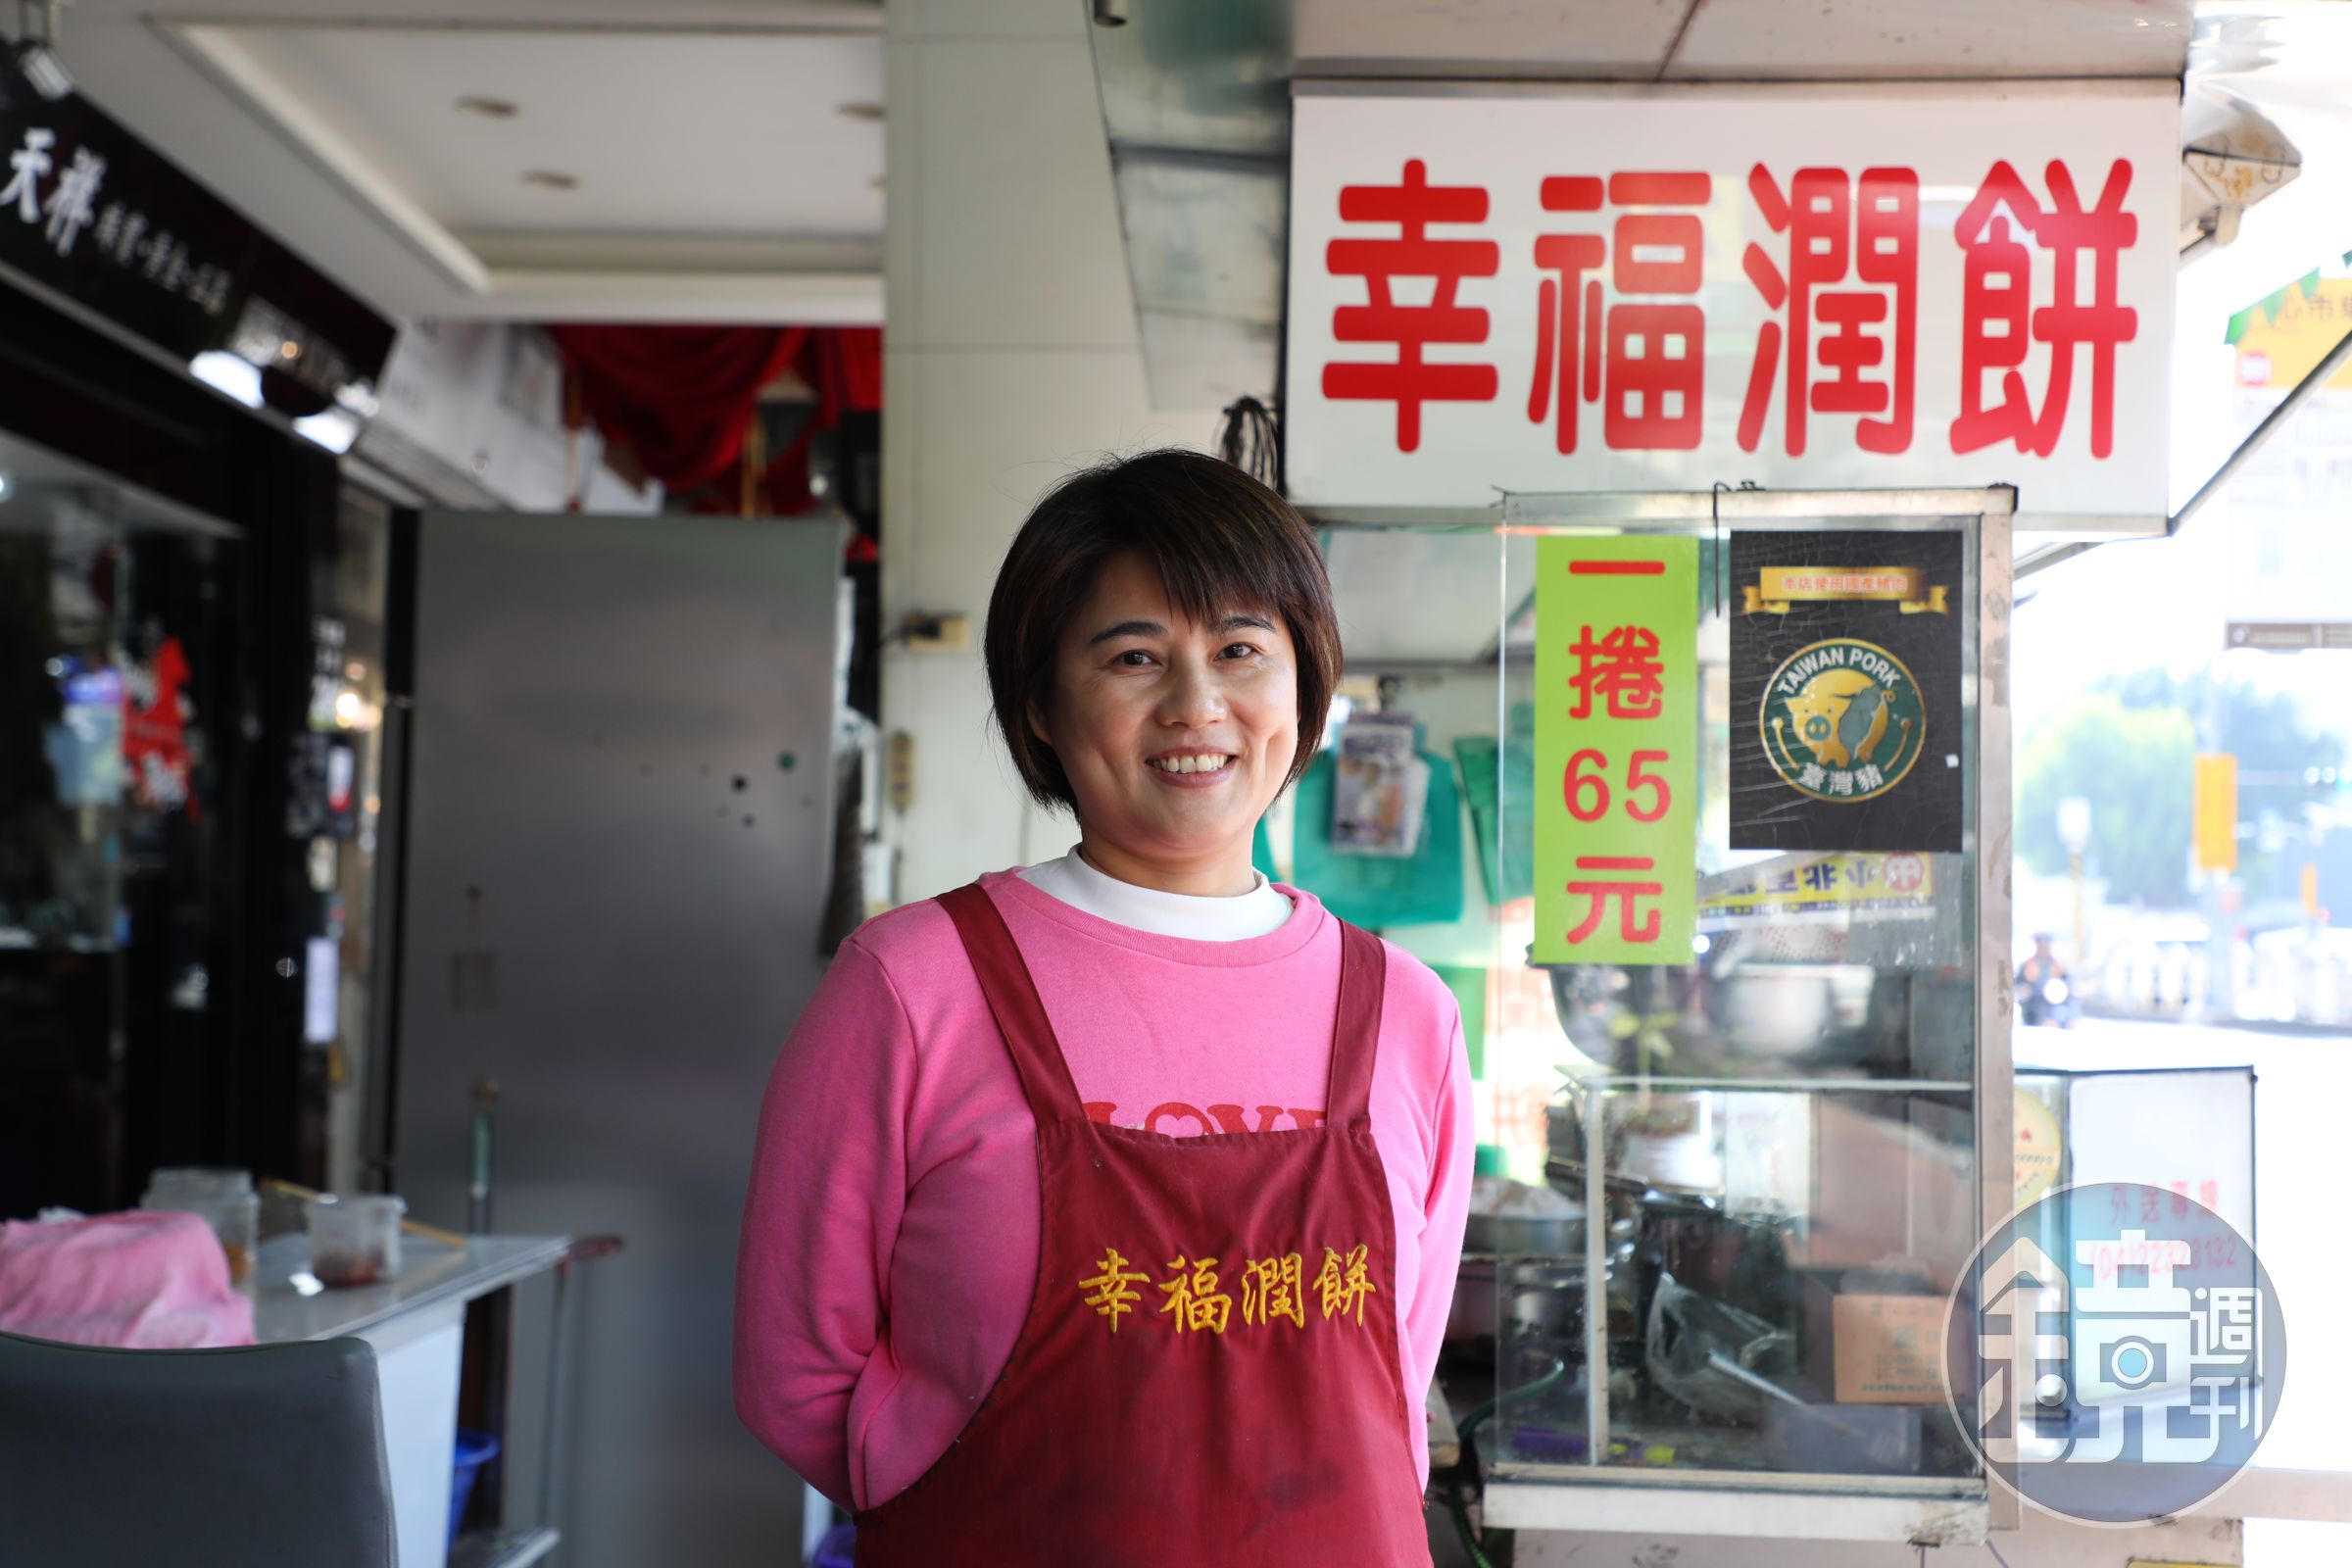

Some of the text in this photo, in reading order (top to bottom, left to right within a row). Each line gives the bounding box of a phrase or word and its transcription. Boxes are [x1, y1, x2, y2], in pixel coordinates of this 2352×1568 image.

[1321, 158, 2138, 458] 幸福潤餅
[1777, 647, 1901, 695] TAIWAN PORK
[1079, 1243, 1376, 1335] 幸福潤餅
